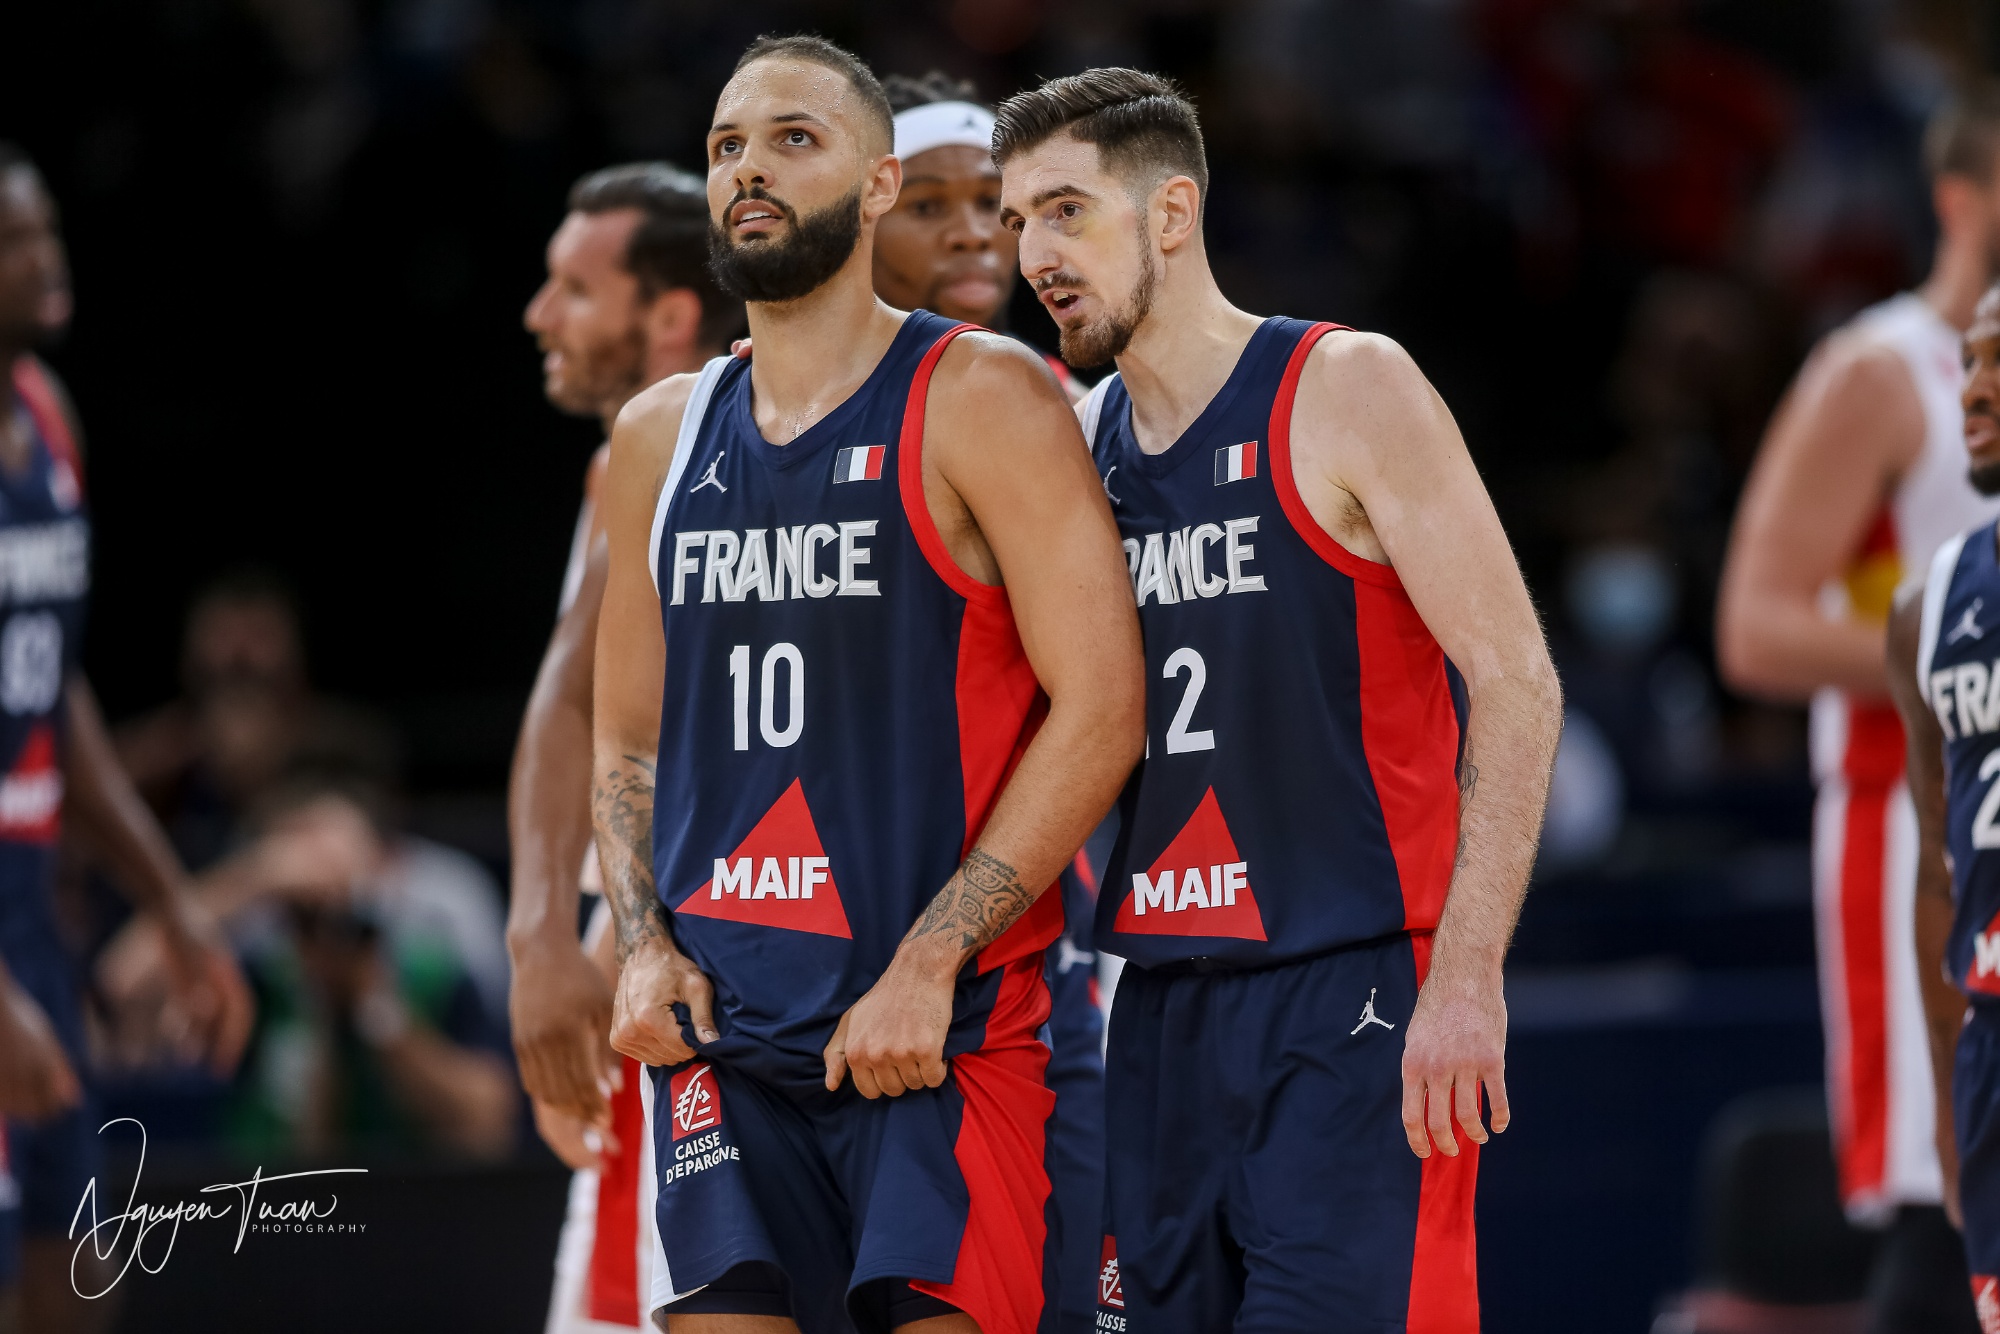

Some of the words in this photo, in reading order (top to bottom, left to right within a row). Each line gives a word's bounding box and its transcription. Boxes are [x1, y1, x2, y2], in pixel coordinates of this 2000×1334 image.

[670, 520, 881, 606] FRANCE
[1122, 515, 1269, 608] ANCE
[729, 642, 804, 751] 10
[1146, 647, 1215, 760] 2
[710, 856, 829, 901] MAIF
[1132, 861, 1248, 917] MAIF
[666, 1145, 740, 1185] D'EPARGNE
[675, 1131, 721, 1161] CAISSE
[1096, 1310, 1127, 1332] AISSE
